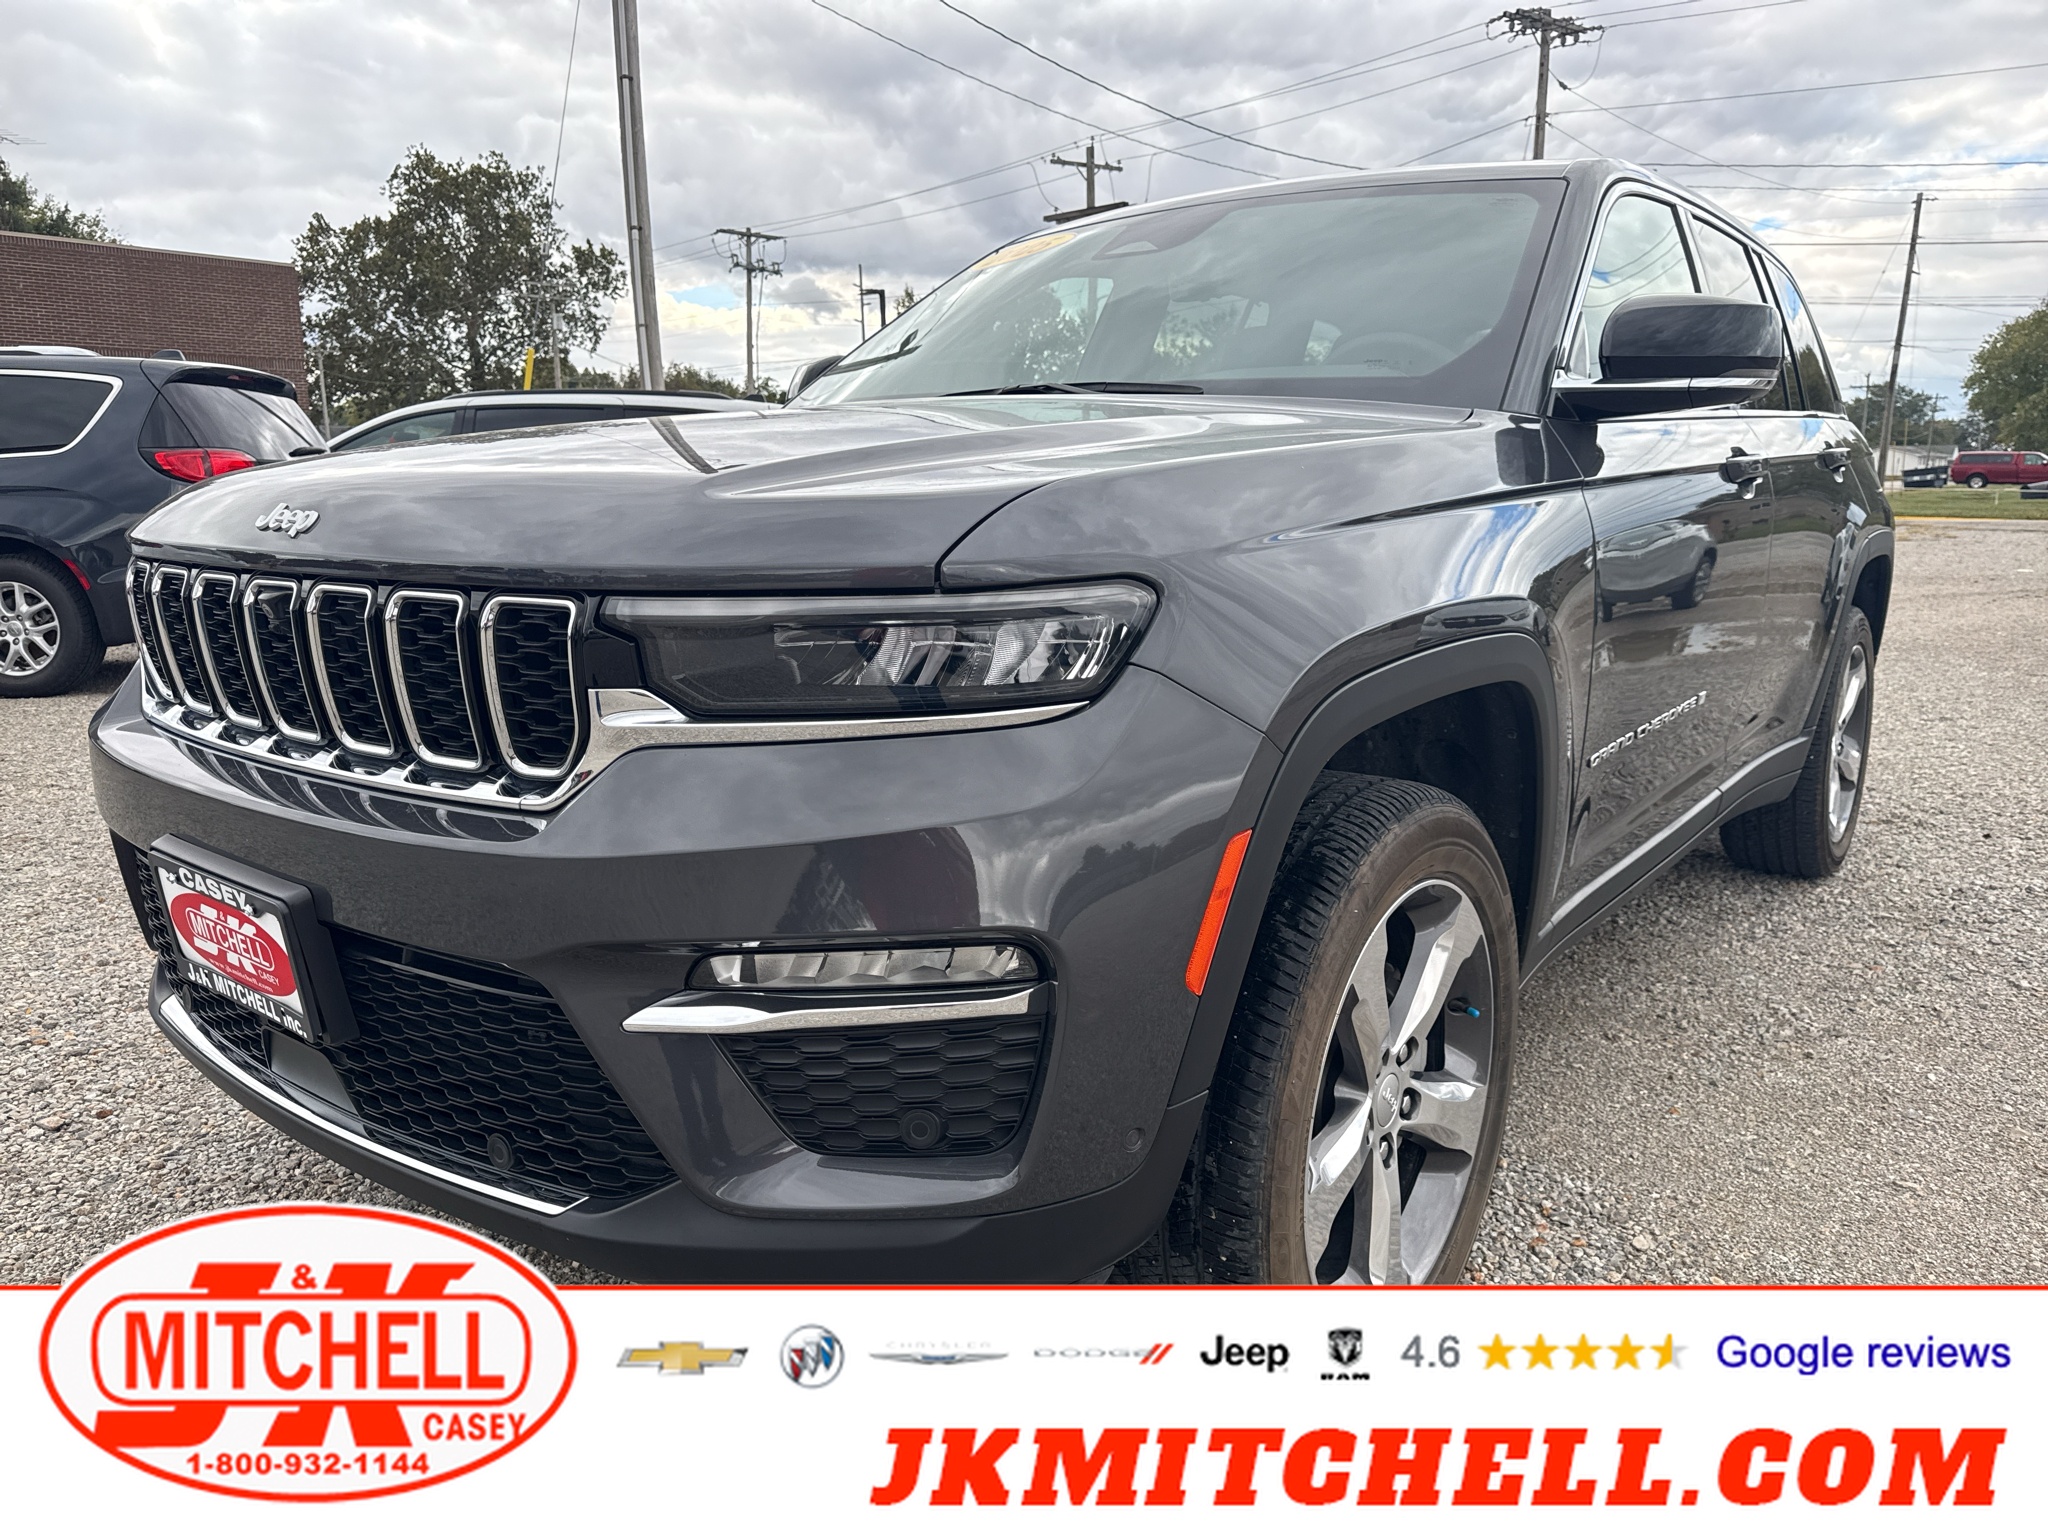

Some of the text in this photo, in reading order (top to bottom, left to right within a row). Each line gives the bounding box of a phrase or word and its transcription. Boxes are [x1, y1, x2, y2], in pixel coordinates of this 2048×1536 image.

[255, 502, 320, 539] Jeep
[1589, 694, 1698, 768] GRAND CHEROKEE
[178, 867, 247, 912] CASEY
[189, 912, 270, 967] MITCHELL
[213, 972, 281, 1023] MITCHELL
